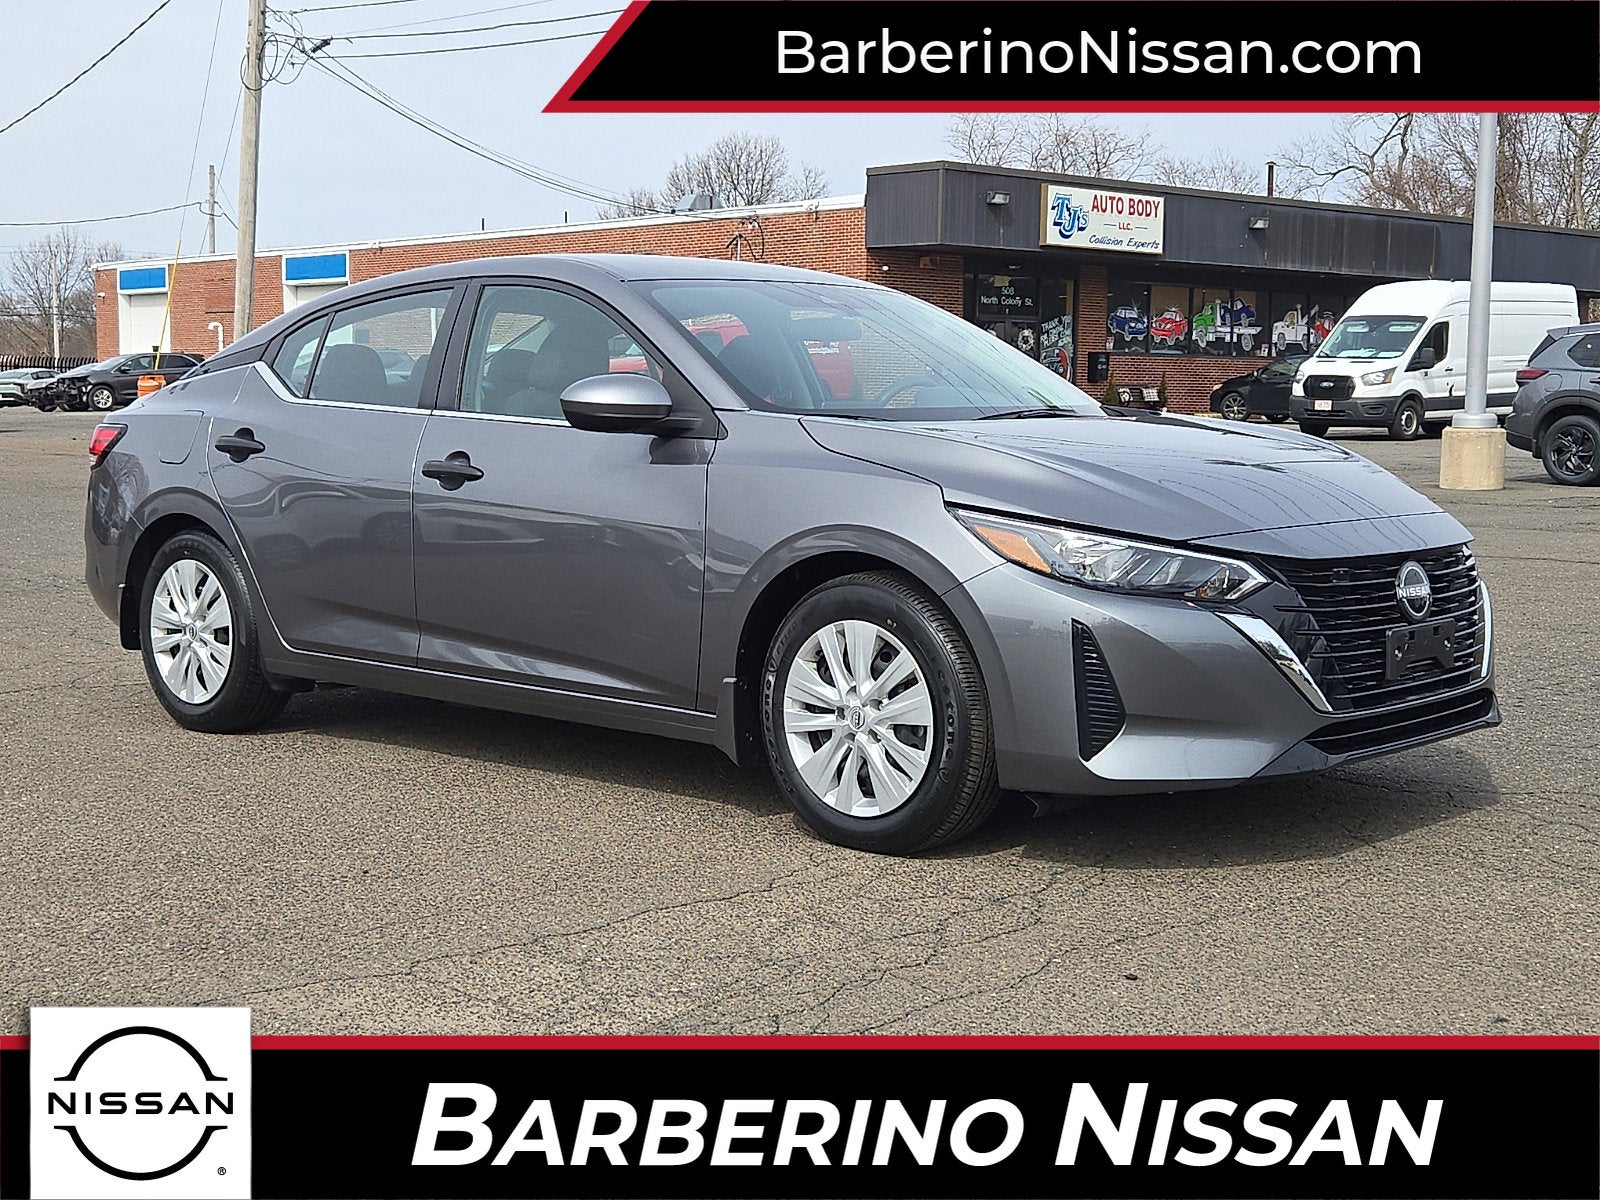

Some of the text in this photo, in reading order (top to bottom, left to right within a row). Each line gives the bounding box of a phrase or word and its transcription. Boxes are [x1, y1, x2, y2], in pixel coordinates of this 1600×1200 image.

[1091, 194, 1161, 218] AUTO BODY
[1051, 192, 1090, 239] TJ's
[1088, 234, 1160, 250] Collision Experts
[1001, 286, 1015, 295] 508
[980, 295, 999, 305] North
[1000, 296, 1023, 307] Colony
